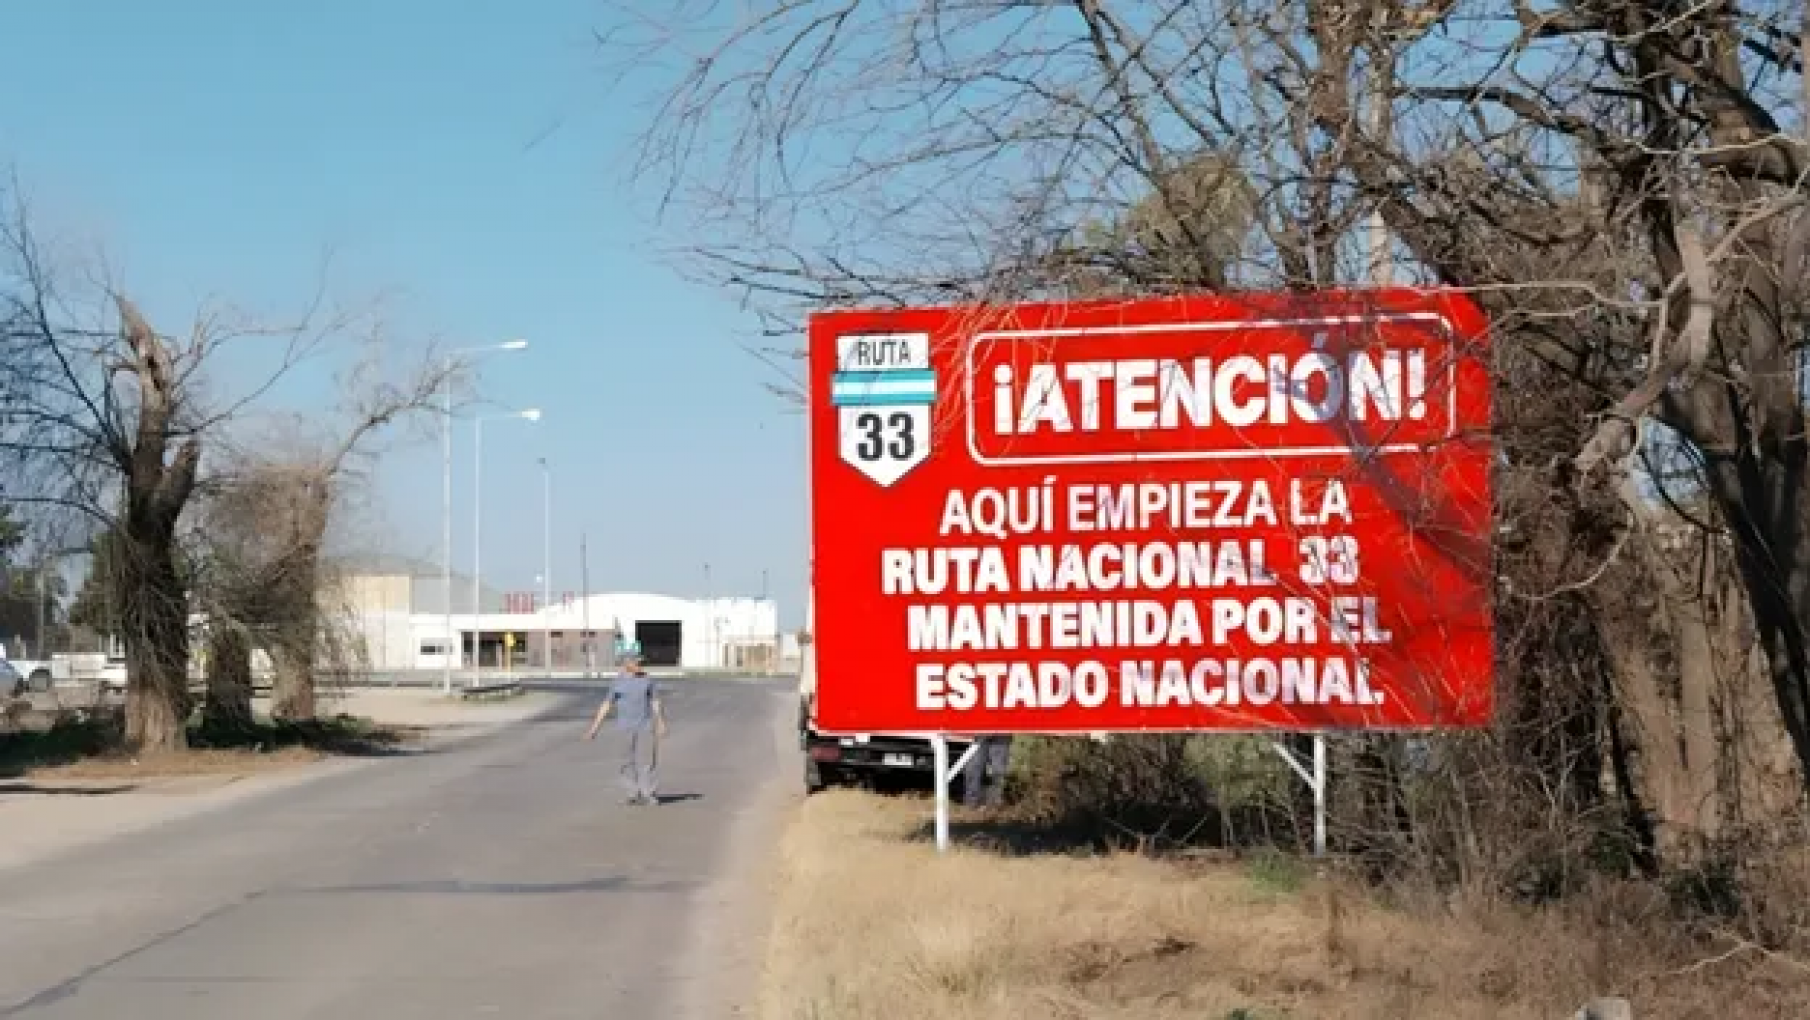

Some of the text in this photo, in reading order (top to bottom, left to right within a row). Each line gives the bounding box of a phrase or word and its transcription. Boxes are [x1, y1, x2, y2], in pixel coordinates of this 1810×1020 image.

[857, 338, 912, 366] RUTA
[994, 333, 1427, 434] ¡ATENCIÓN!
[856, 413, 915, 461] 33
[940, 475, 1352, 540] AQUÍ EMPIEZA LA
[881, 535, 1359, 595] RUTA NACIONAL 33
[908, 595, 1393, 651] MANTENIDA POR EL
[915, 656, 1385, 710] ESTADO NACIONAL
